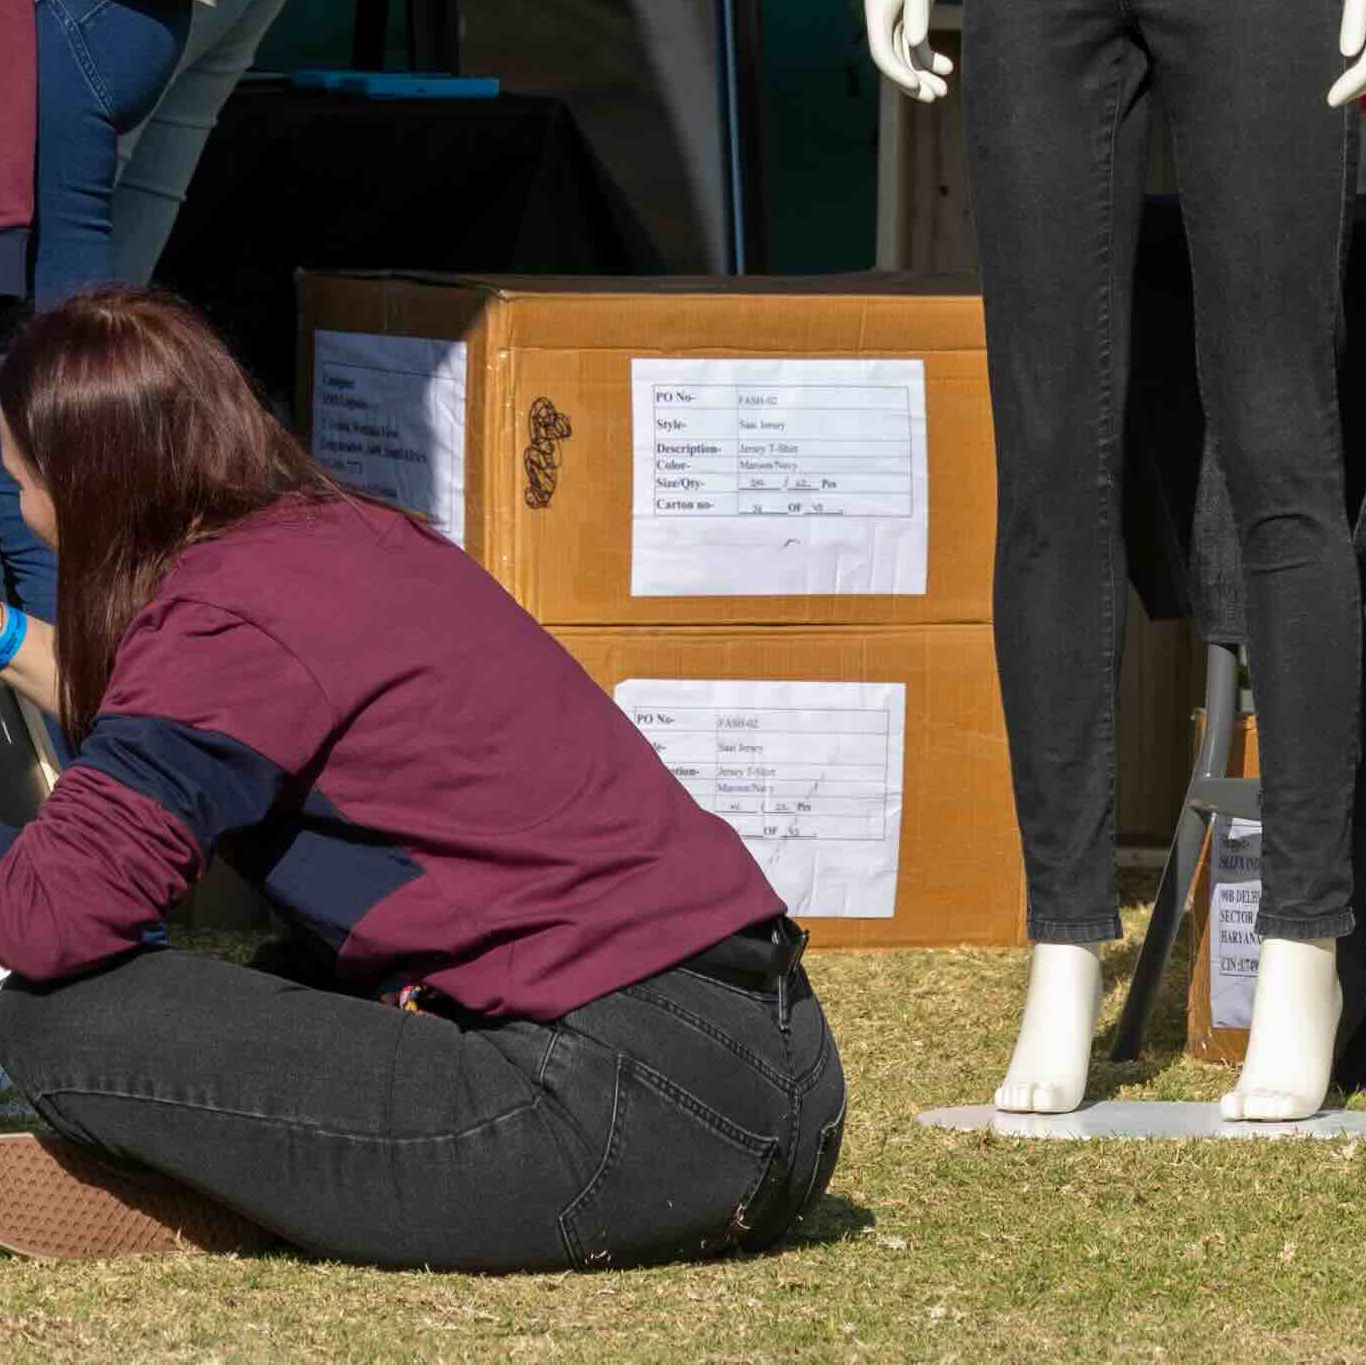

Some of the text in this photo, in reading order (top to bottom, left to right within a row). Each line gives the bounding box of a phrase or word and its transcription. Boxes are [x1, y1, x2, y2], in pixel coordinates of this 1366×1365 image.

[656, 391, 673, 403] PO
[656, 498, 694, 510] Carton
[636, 713, 654, 725] PO
[1220, 910, 1253, 923] SECTOR
